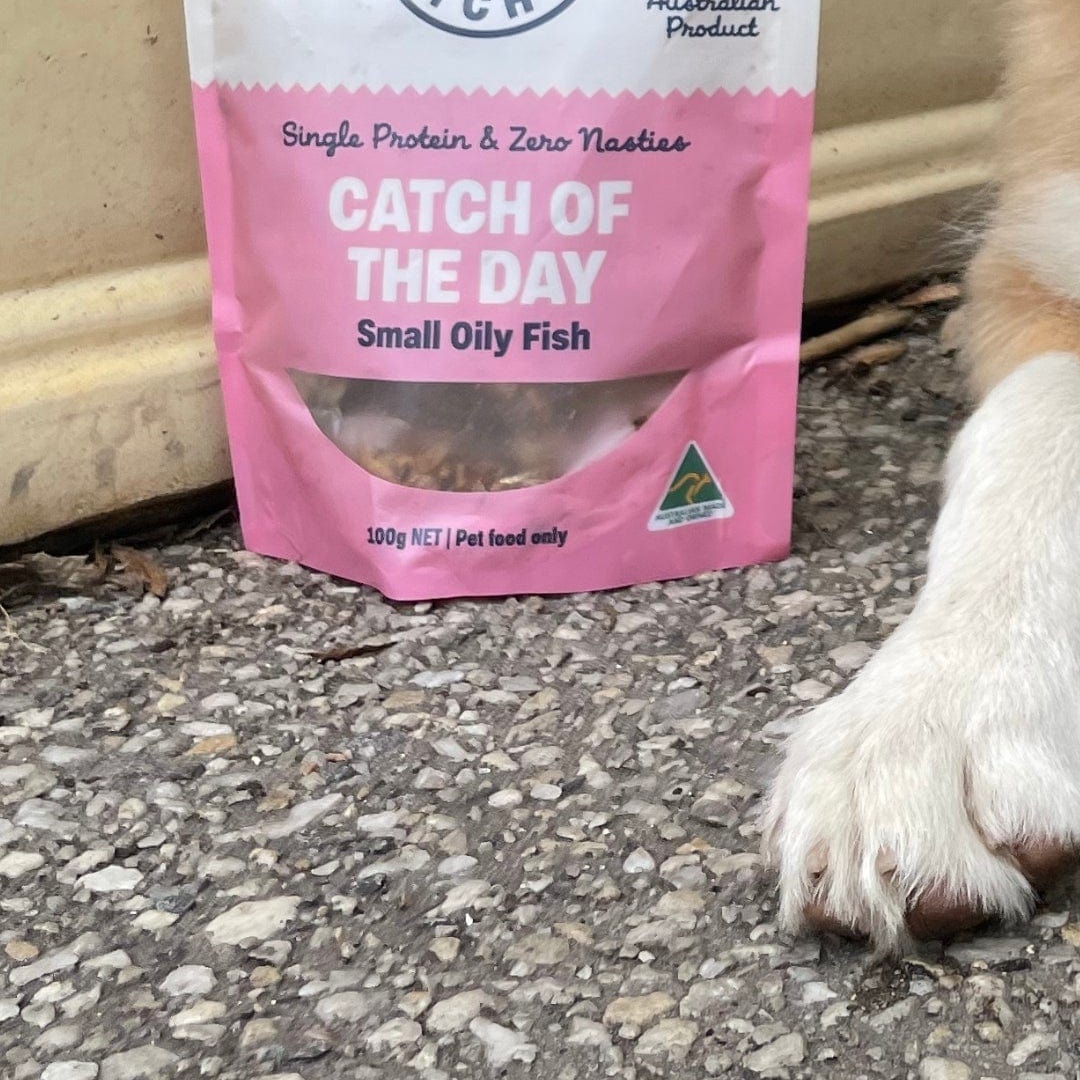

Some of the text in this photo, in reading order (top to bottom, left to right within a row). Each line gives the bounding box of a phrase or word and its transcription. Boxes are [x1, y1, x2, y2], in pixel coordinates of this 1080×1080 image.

[666, 14, 760, 39] Product
[282, 120, 691, 157] Single Protein & Zero Nasties
[328, 176, 633, 235] CATCH OF
[347, 246, 607, 305] THE DAY
[357, 318, 591, 357] Small Oily Fish
[367, 527, 407, 549] 100g
[411, 528, 443, 546] NET
[456, 529, 484, 547] Pet
[488, 528, 526, 547] food
[531, 526, 569, 548] only
